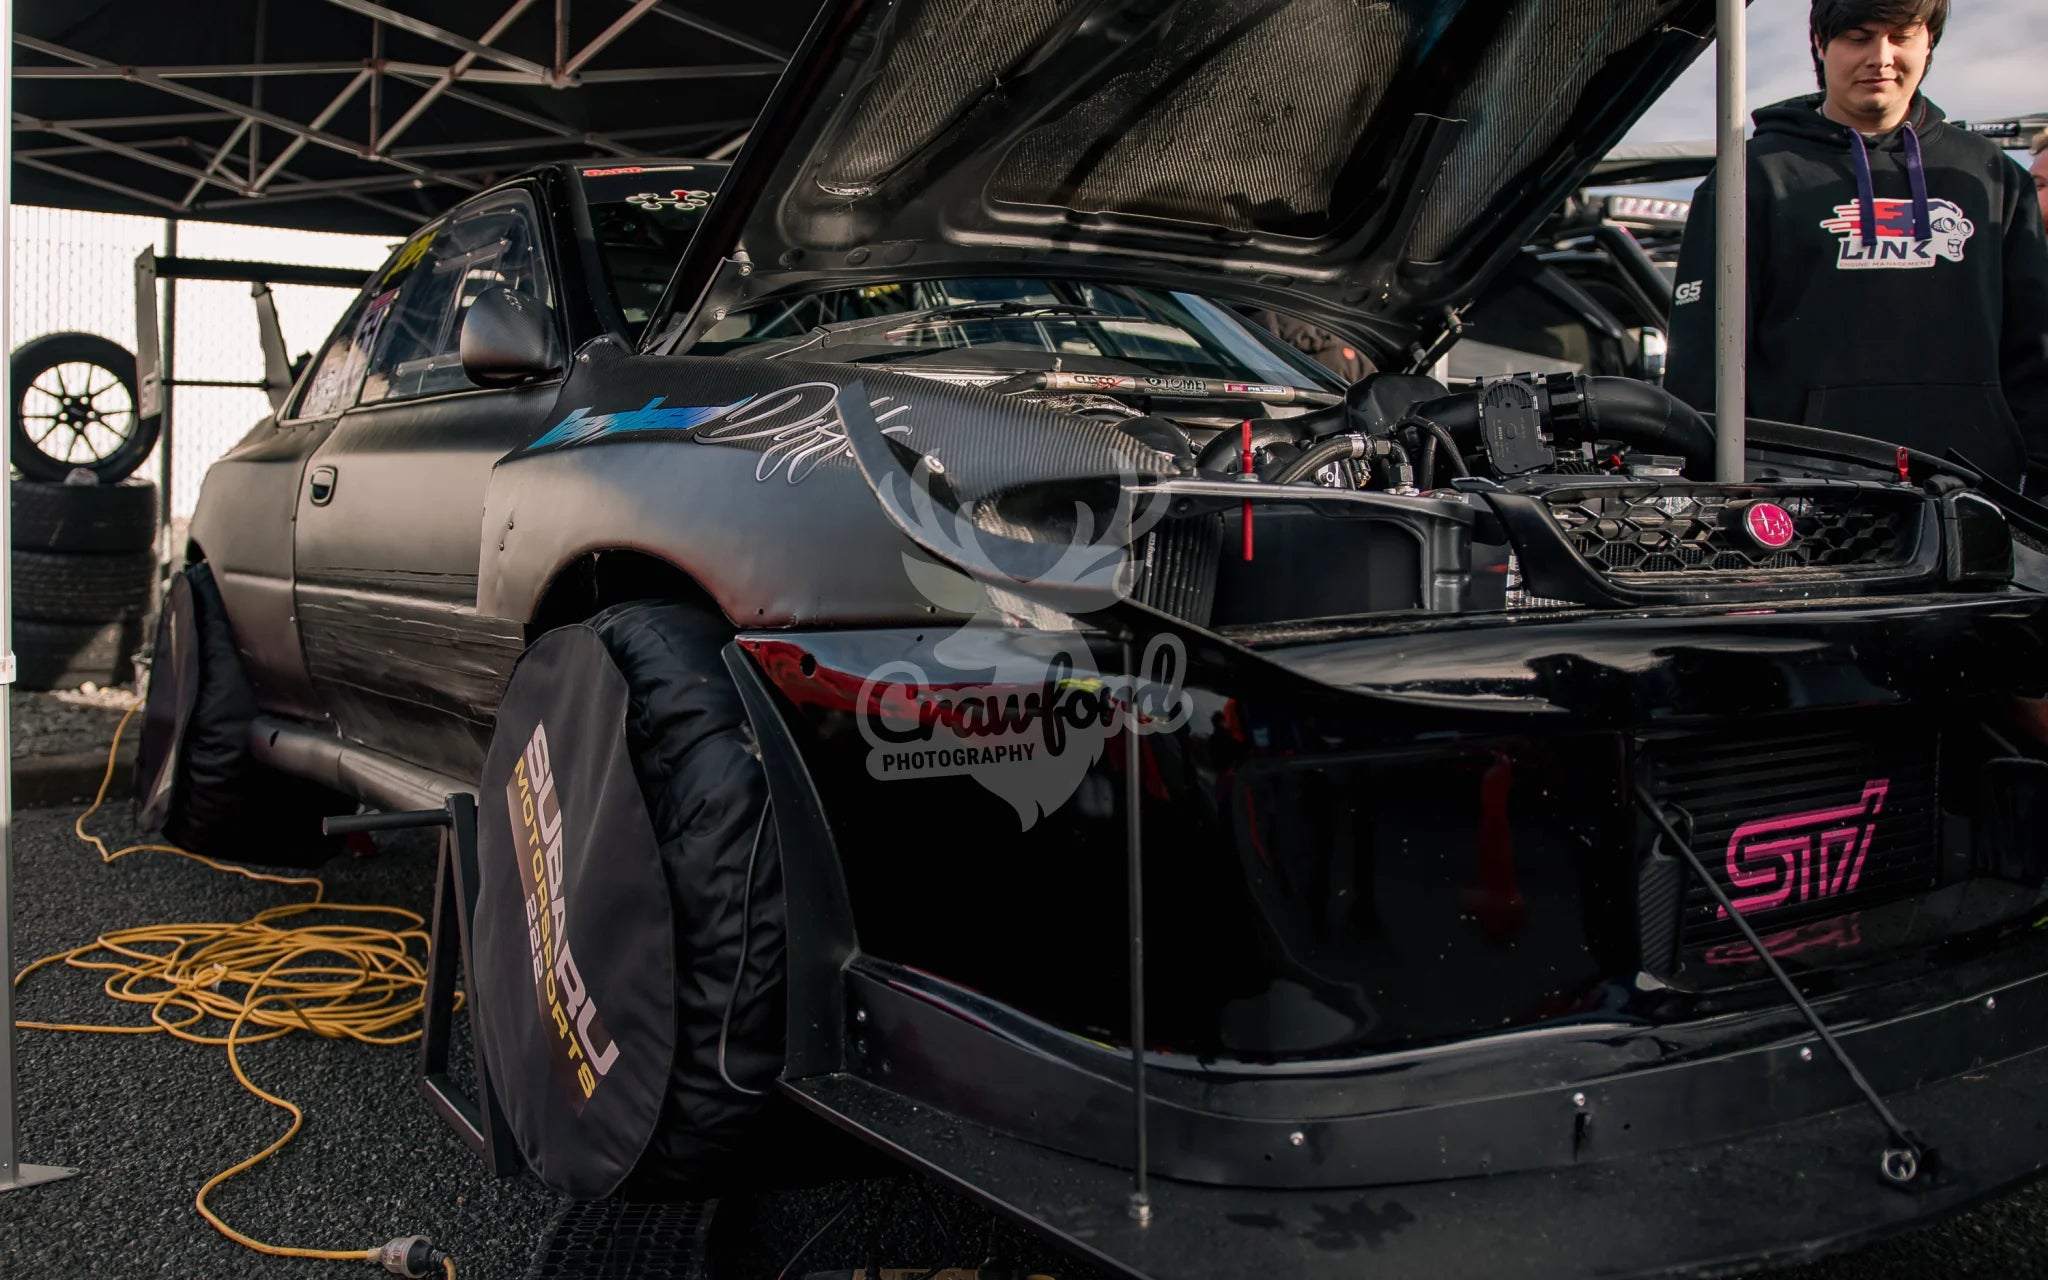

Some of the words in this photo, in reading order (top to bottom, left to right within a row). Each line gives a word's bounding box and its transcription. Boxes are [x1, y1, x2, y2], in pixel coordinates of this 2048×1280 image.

[1841, 240, 1933, 260] LINK
[1872, 260, 1933, 268] MANAGEMENT
[1675, 280, 1703, 299] G5
[1073, 375, 1116, 385] CUSCO
[1162, 378, 1209, 391] TOMEI
[526, 723, 620, 1077] SUBARU
[514, 756, 597, 1099] MOTORSPORTS
[525, 893, 543, 985] 222
